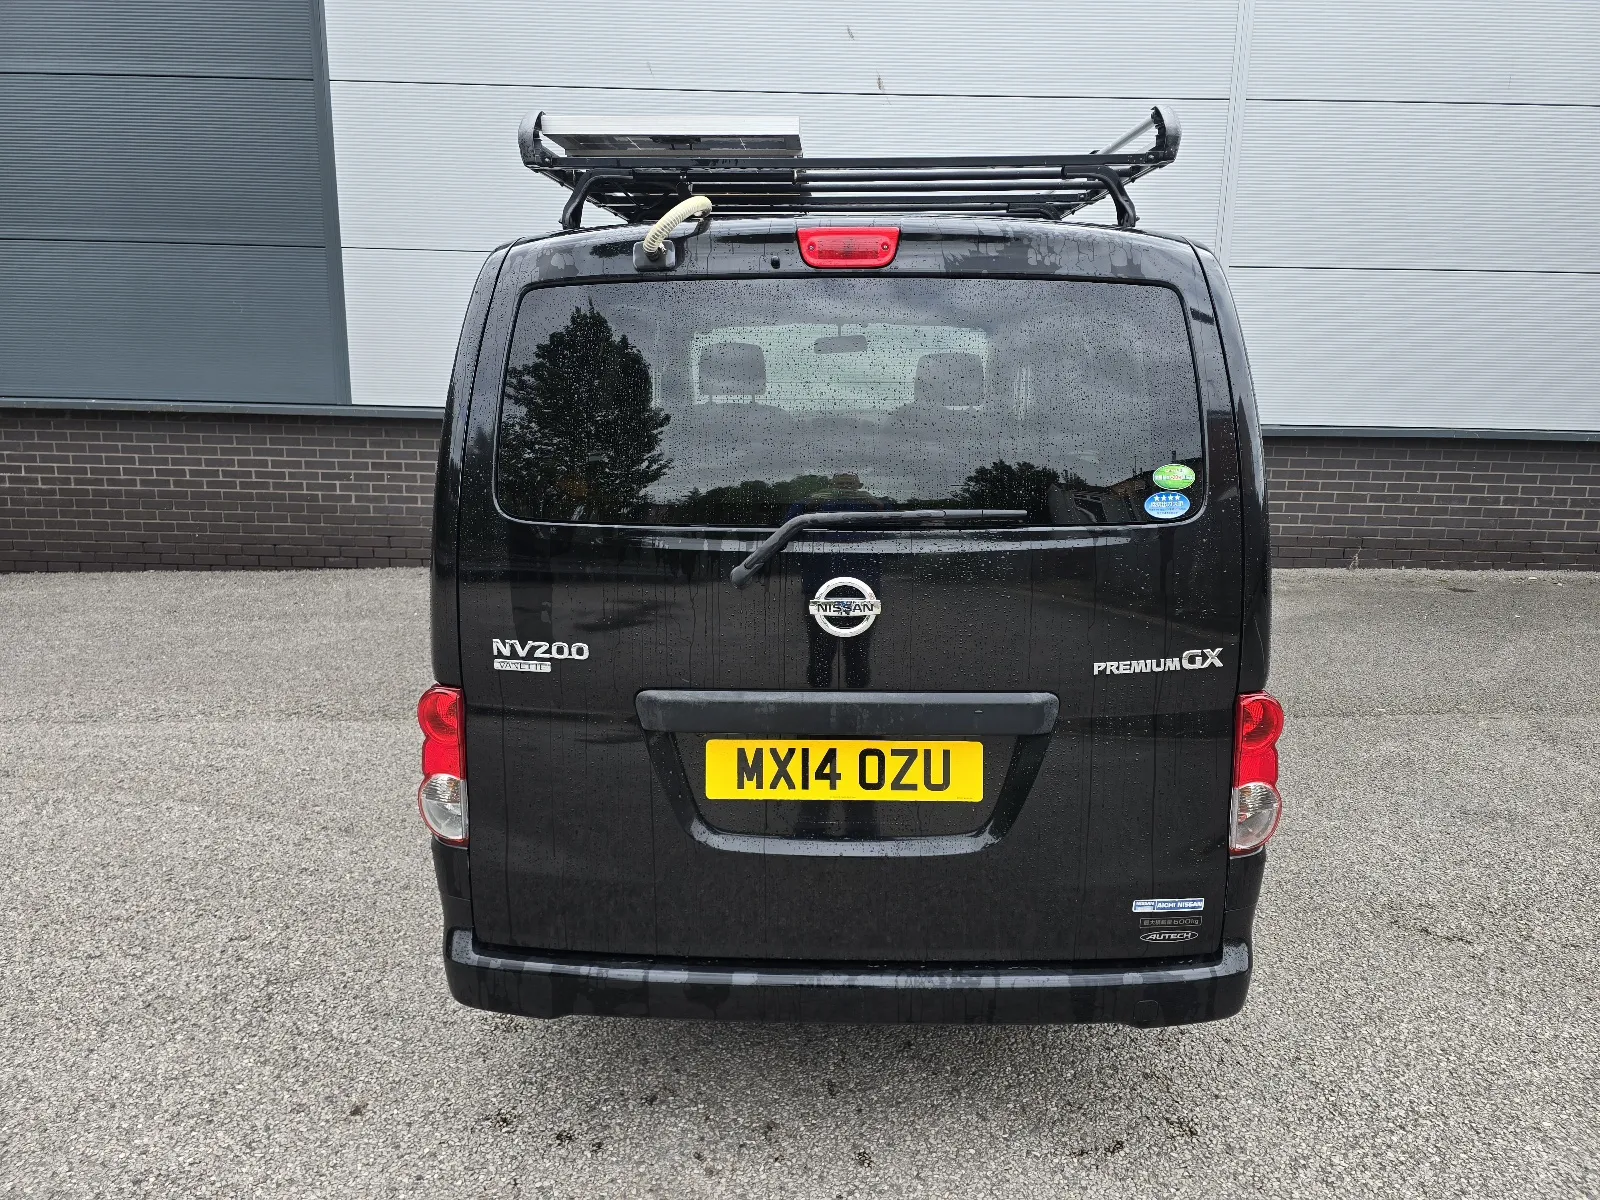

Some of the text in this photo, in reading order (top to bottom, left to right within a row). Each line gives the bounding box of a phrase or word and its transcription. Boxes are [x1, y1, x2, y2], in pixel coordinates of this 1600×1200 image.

[817, 602, 874, 613] NISSAN
[492, 638, 590, 660] NV200
[736, 747, 951, 791] MX14 OZU
[1146, 932, 1192, 940] AUTECH
